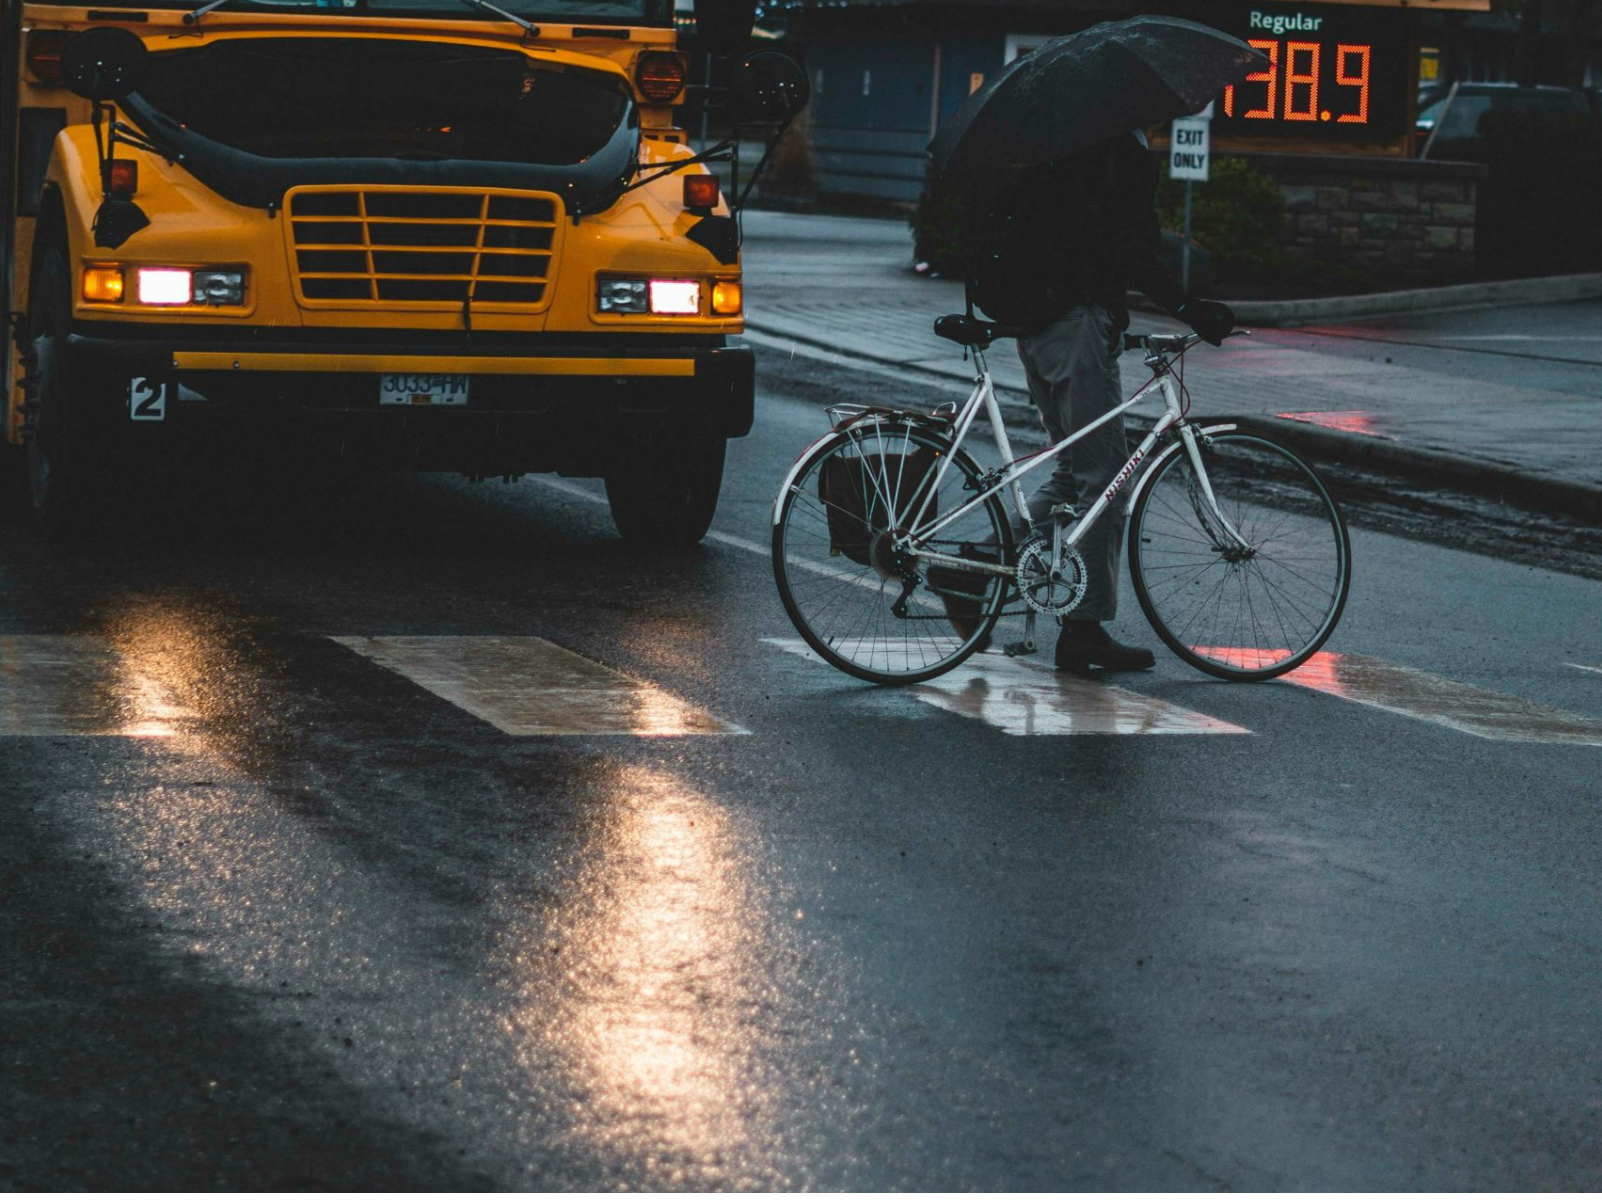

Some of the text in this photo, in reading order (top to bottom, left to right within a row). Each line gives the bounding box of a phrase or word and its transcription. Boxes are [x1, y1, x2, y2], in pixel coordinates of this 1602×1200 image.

[1250, 11, 1322, 34] Regular
[1176, 128, 1204, 146] EXIT
[1173, 152, 1205, 170] ONLY
[134, 379, 163, 417] 2
[1105, 448, 1145, 502] NISHIKI
